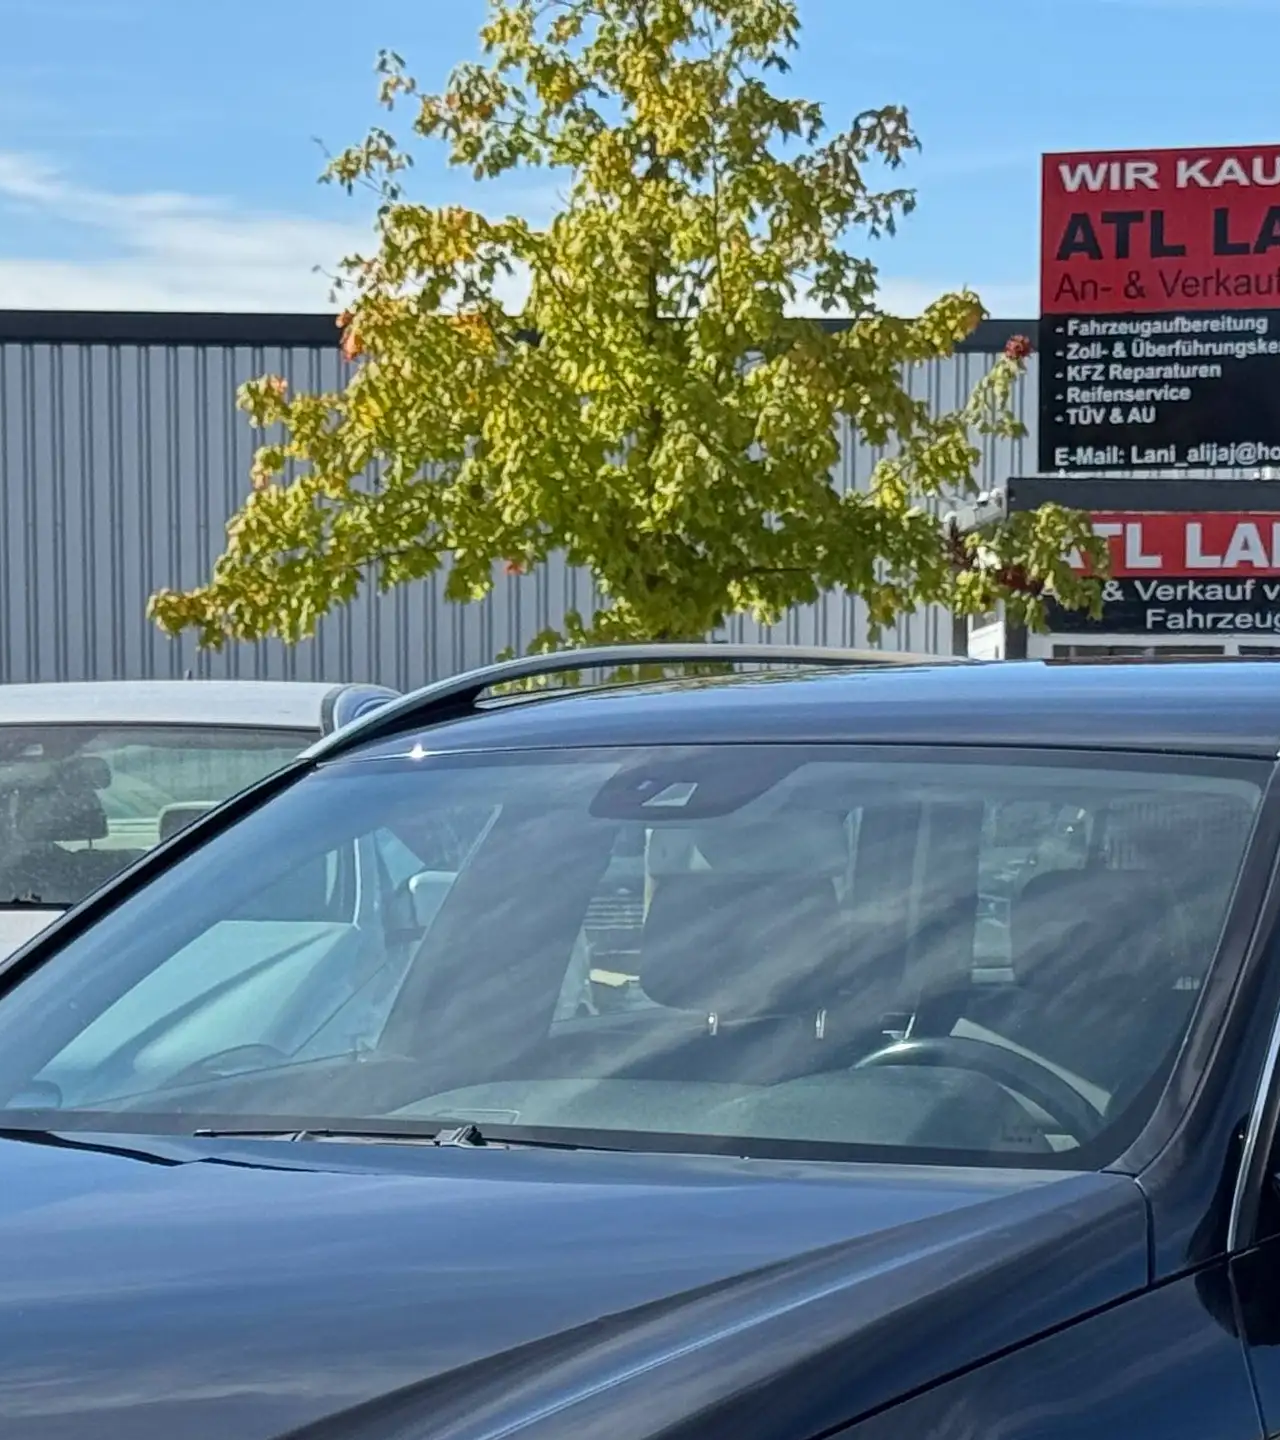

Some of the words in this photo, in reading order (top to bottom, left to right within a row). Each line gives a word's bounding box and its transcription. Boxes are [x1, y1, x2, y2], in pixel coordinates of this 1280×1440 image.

[1058, 159, 1159, 192] WIR
[1056, 210, 1187, 261] ATL
[1054, 273, 1112, 302] An-
[1124, 271, 1146, 299] &
[1067, 316, 1268, 337] Fahrzeugaufbereitung
[1066, 343, 1109, 360] Zoll-
[1112, 341, 1127, 358] &
[1067, 366, 1105, 382] KFZ
[1109, 363, 1222, 383] Reparaturen
[1067, 385, 1191, 404] Reifenservice
[1067, 405, 1106, 425] TÜV
[1110, 407, 1123, 424] &
[1127, 406, 1156, 423] AU
[1055, 446, 1124, 466] E-Mail:
[1101, 580, 1124, 601] &
[1134, 579, 1256, 601] Verkauf
